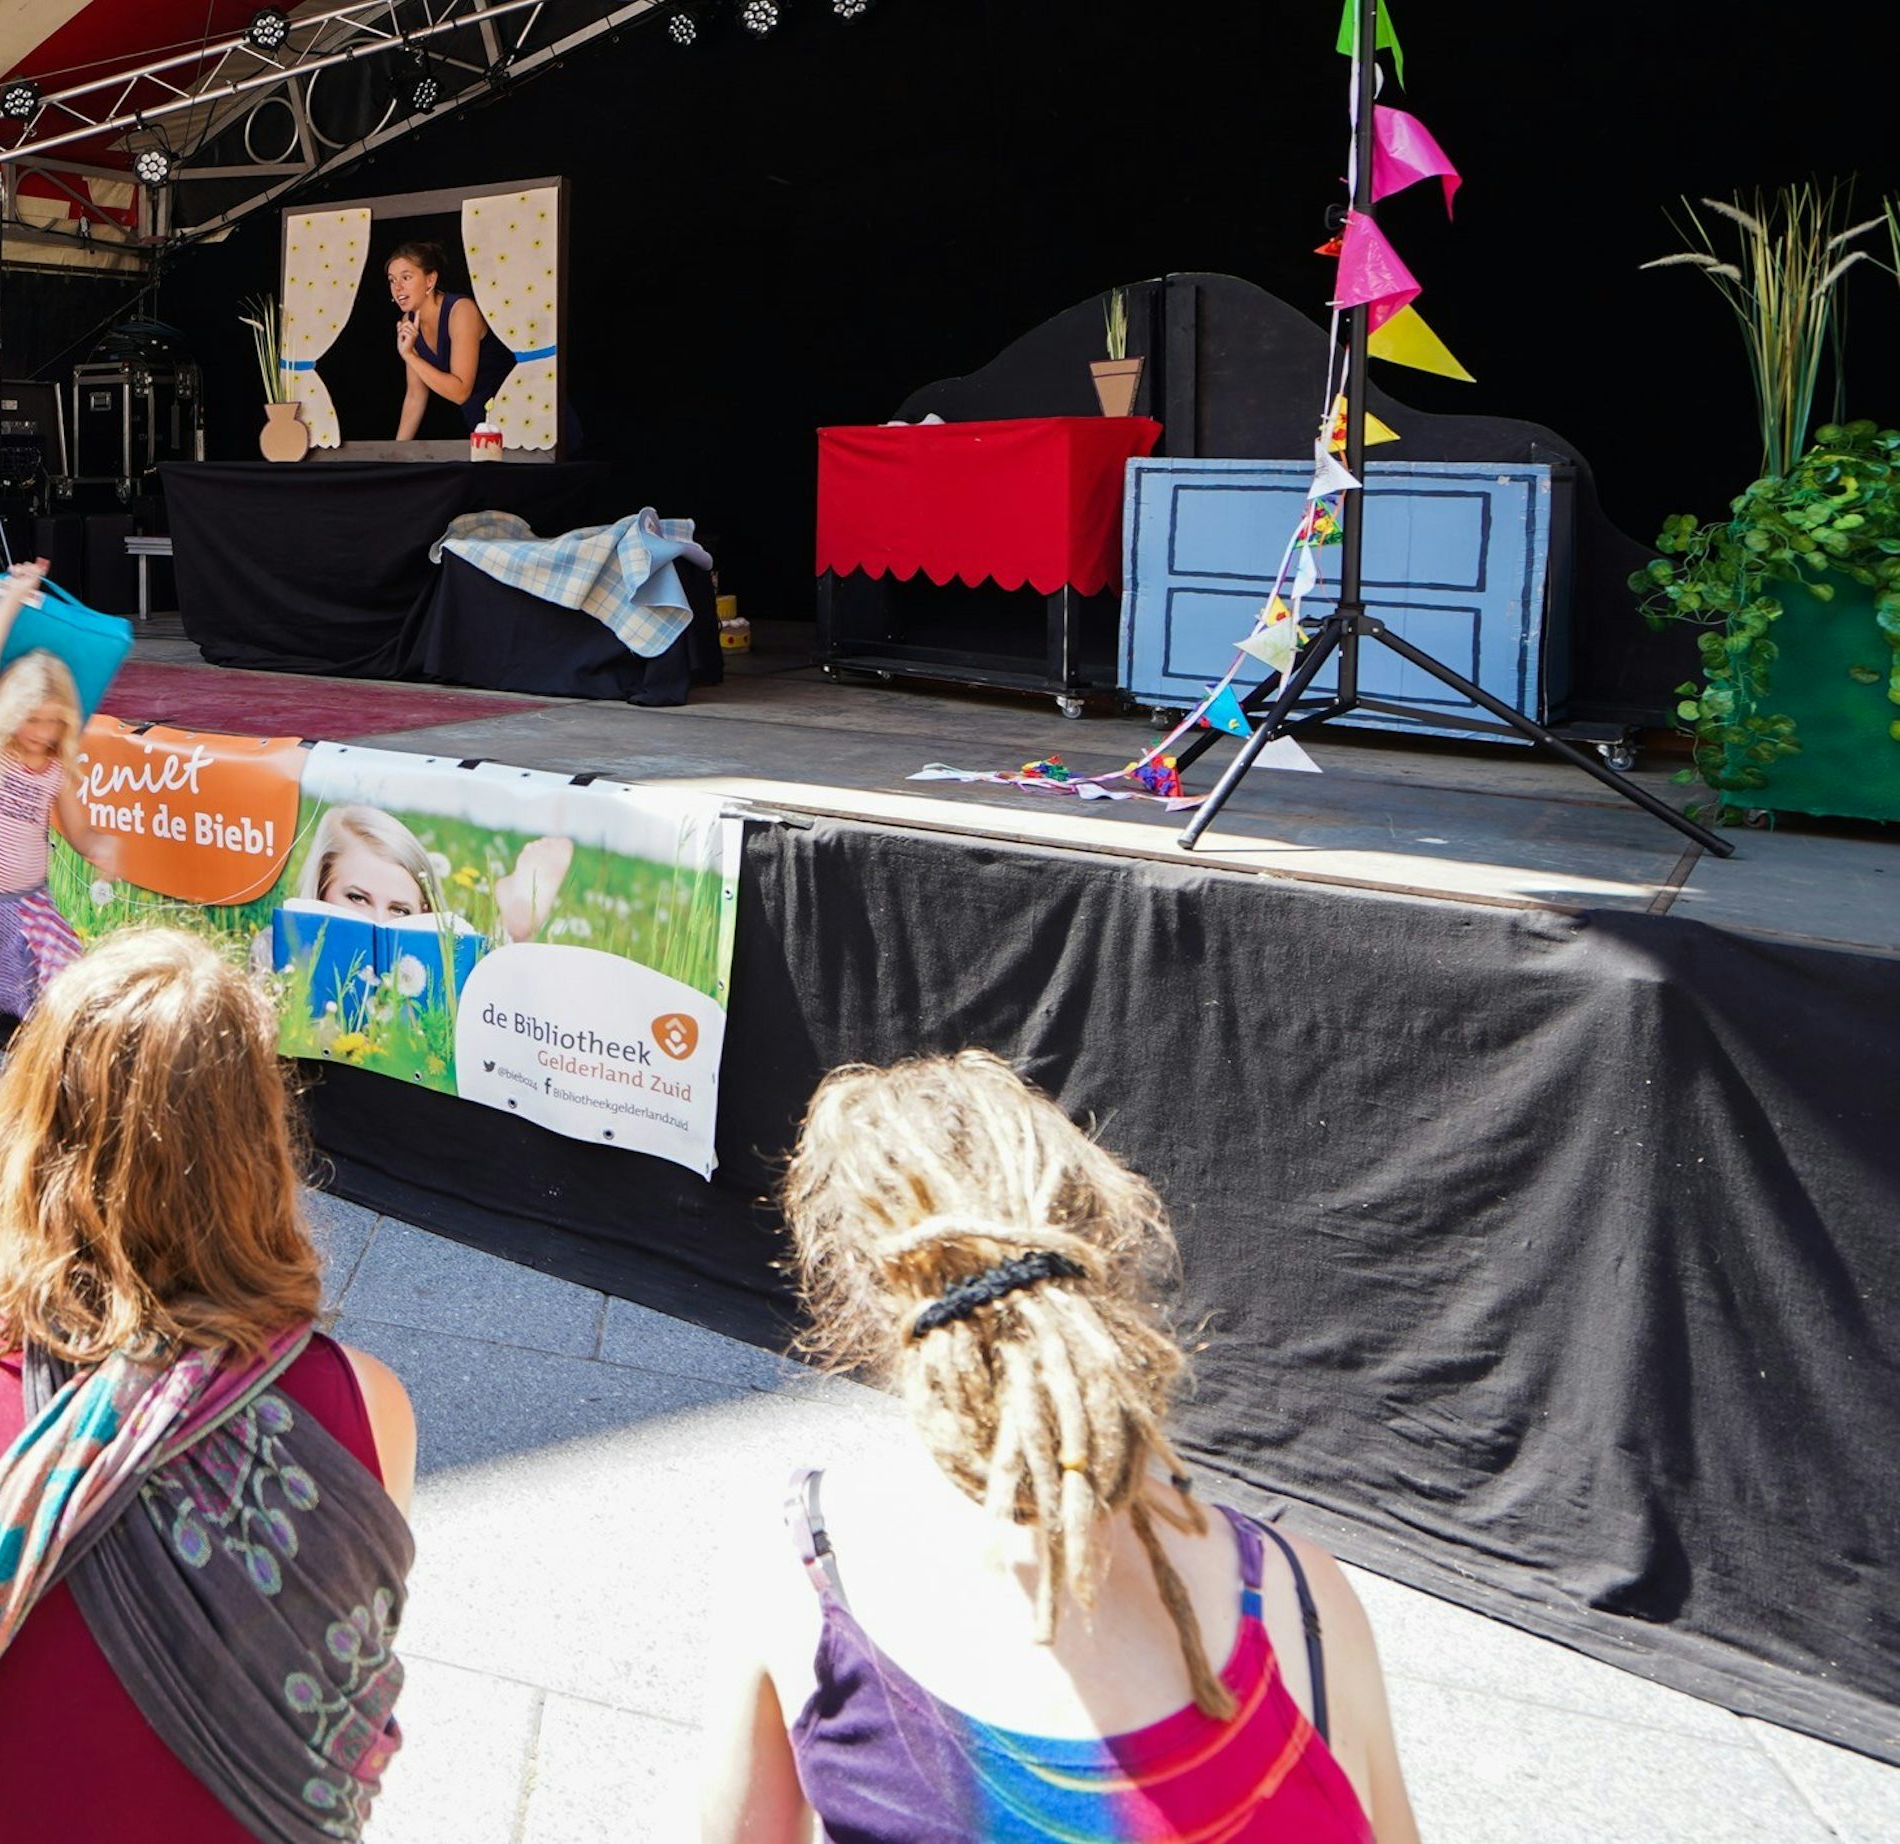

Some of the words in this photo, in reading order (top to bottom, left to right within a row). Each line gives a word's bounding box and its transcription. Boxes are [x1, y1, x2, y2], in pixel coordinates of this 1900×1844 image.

[89, 802, 145, 834] met
[152, 804, 187, 842] de
[195, 811, 274, 857] Bieb!
[482, 1002, 508, 1029] de
[514, 1012, 652, 1066] Bibliotheek
[537, 1050, 644, 1088] Gelderland
[650, 1074, 693, 1103] Zuid
[553, 1087, 690, 1132] Bibliotheekgelderlandzuid
